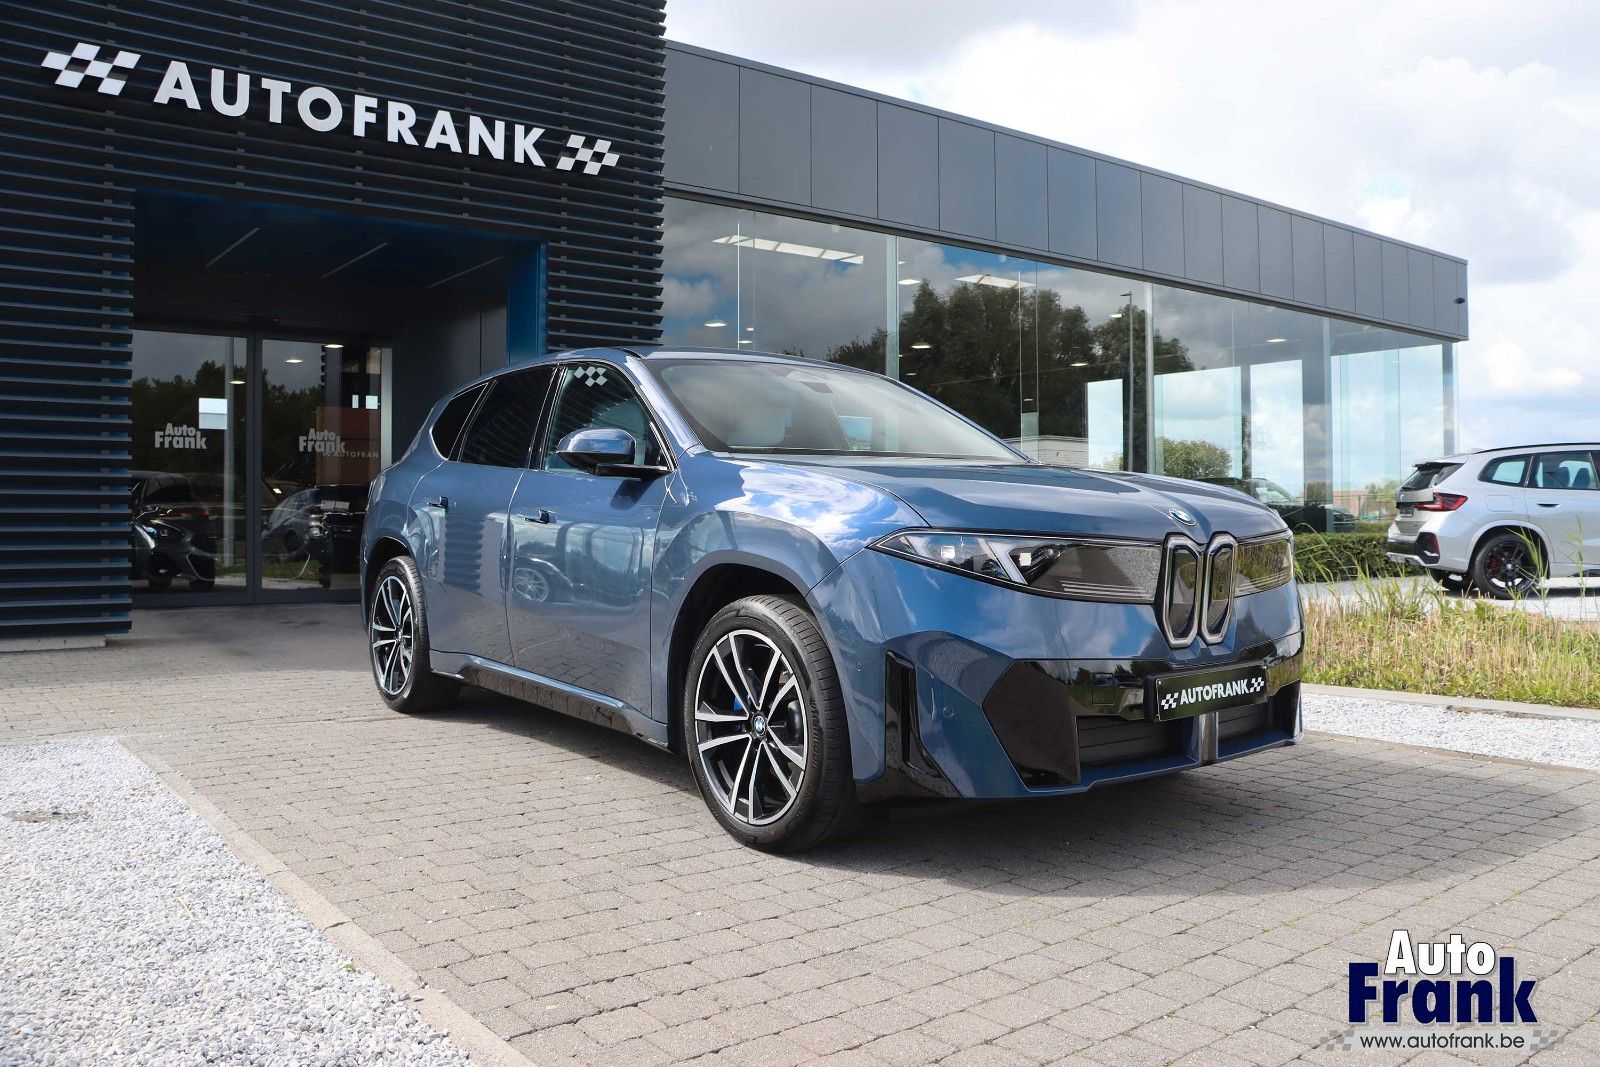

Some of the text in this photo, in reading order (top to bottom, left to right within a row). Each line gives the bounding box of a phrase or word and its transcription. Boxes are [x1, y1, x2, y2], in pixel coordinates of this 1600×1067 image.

[153, 60, 547, 168] AUTOFRANK
[165, 422, 196, 436] Auto
[308, 428, 336, 440] Auto
[155, 431, 207, 449] Frank
[299, 436, 345, 453] Frank
[333, 450, 379, 458] AUTOFRAN
[1180, 679, 1250, 705] AUTOFRANK
